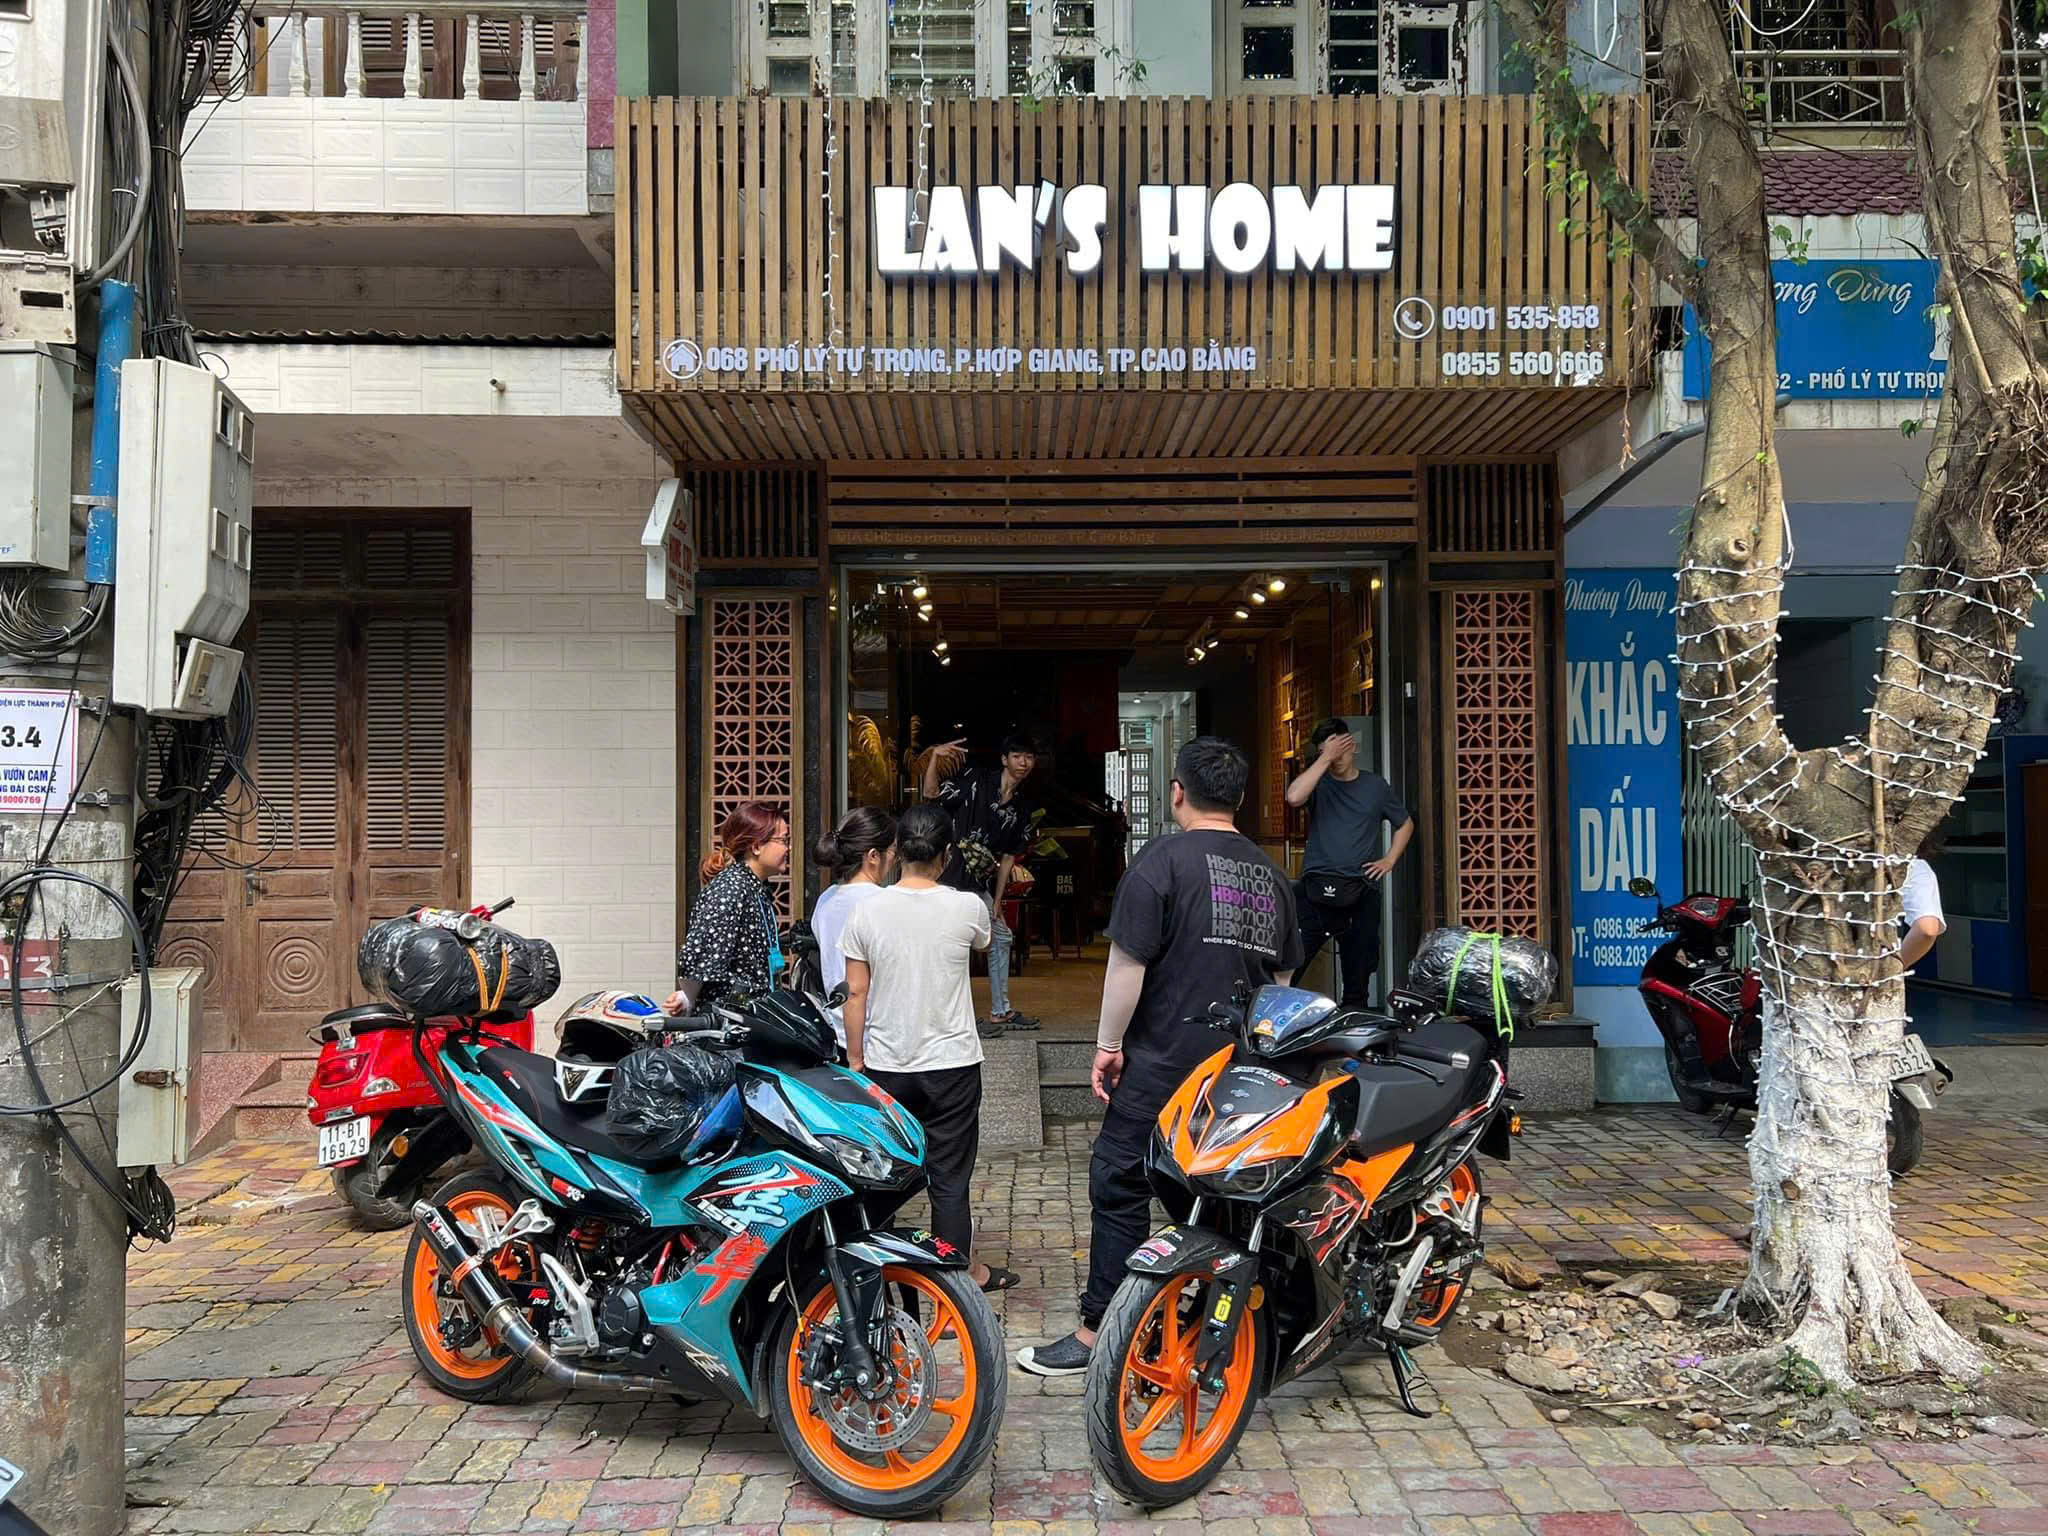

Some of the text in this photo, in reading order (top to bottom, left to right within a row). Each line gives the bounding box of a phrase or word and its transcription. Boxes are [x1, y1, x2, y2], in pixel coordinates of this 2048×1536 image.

[873, 179, 1395, 275] LAN'S HOME
[1442, 305, 1600, 330] 0901 535 858
[707, 347, 748, 372] 068
[755, 340, 799, 372] PHỐ
[803, 343, 827, 372] LÝ
[834, 344, 865, 376] TỰ
[1192, 338, 1257, 372] BẰNG
[1442, 351, 1604, 376] 0855 560 666
[1809, 366, 1845, 389] PHỐ
[1851, 369, 1872, 389] LÝ
[1877, 370, 1901, 392] TỰ
[1625, 578, 1667, 618] Dung
[1566, 631, 1667, 746] KHẮC
[28, 769, 48, 781] CAM
[1579, 776, 1656, 892] DẤU
[328, 1121, 361, 1143] 11-B1
